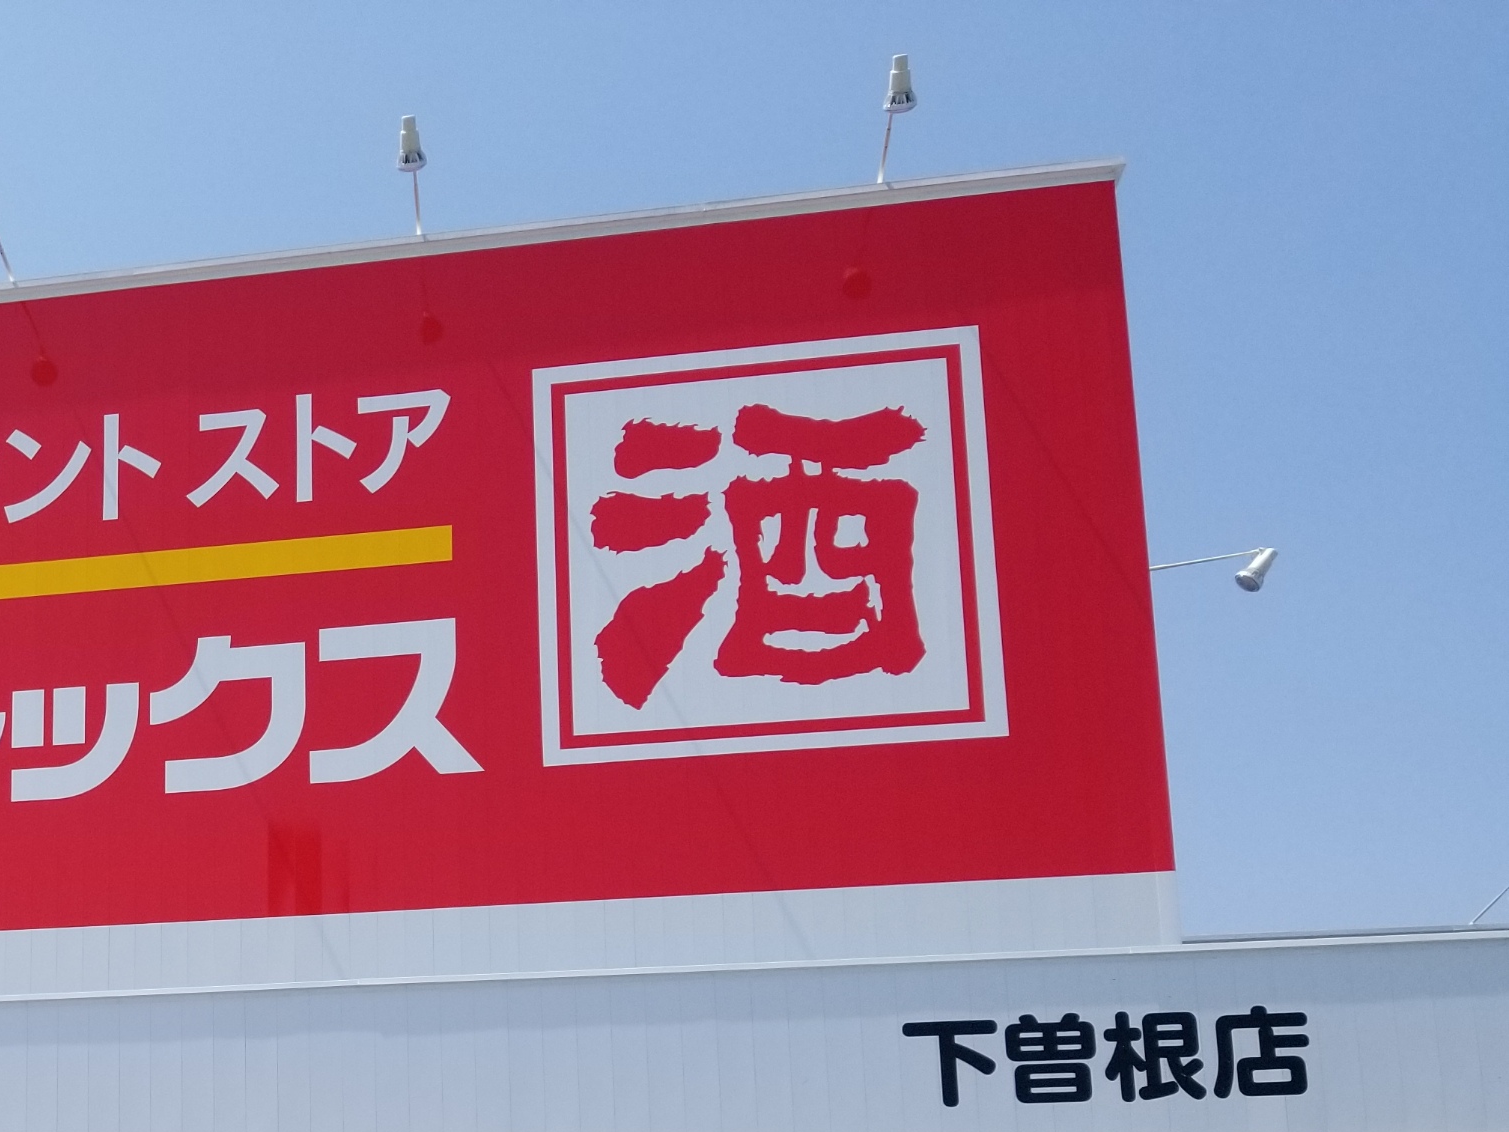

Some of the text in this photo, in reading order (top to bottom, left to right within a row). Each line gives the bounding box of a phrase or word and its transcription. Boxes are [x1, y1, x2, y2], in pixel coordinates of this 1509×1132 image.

[186, 388, 452, 509] ストア
[589, 403, 928, 710] 酒
[901, 1005, 1311, 1108] 下曽根店
